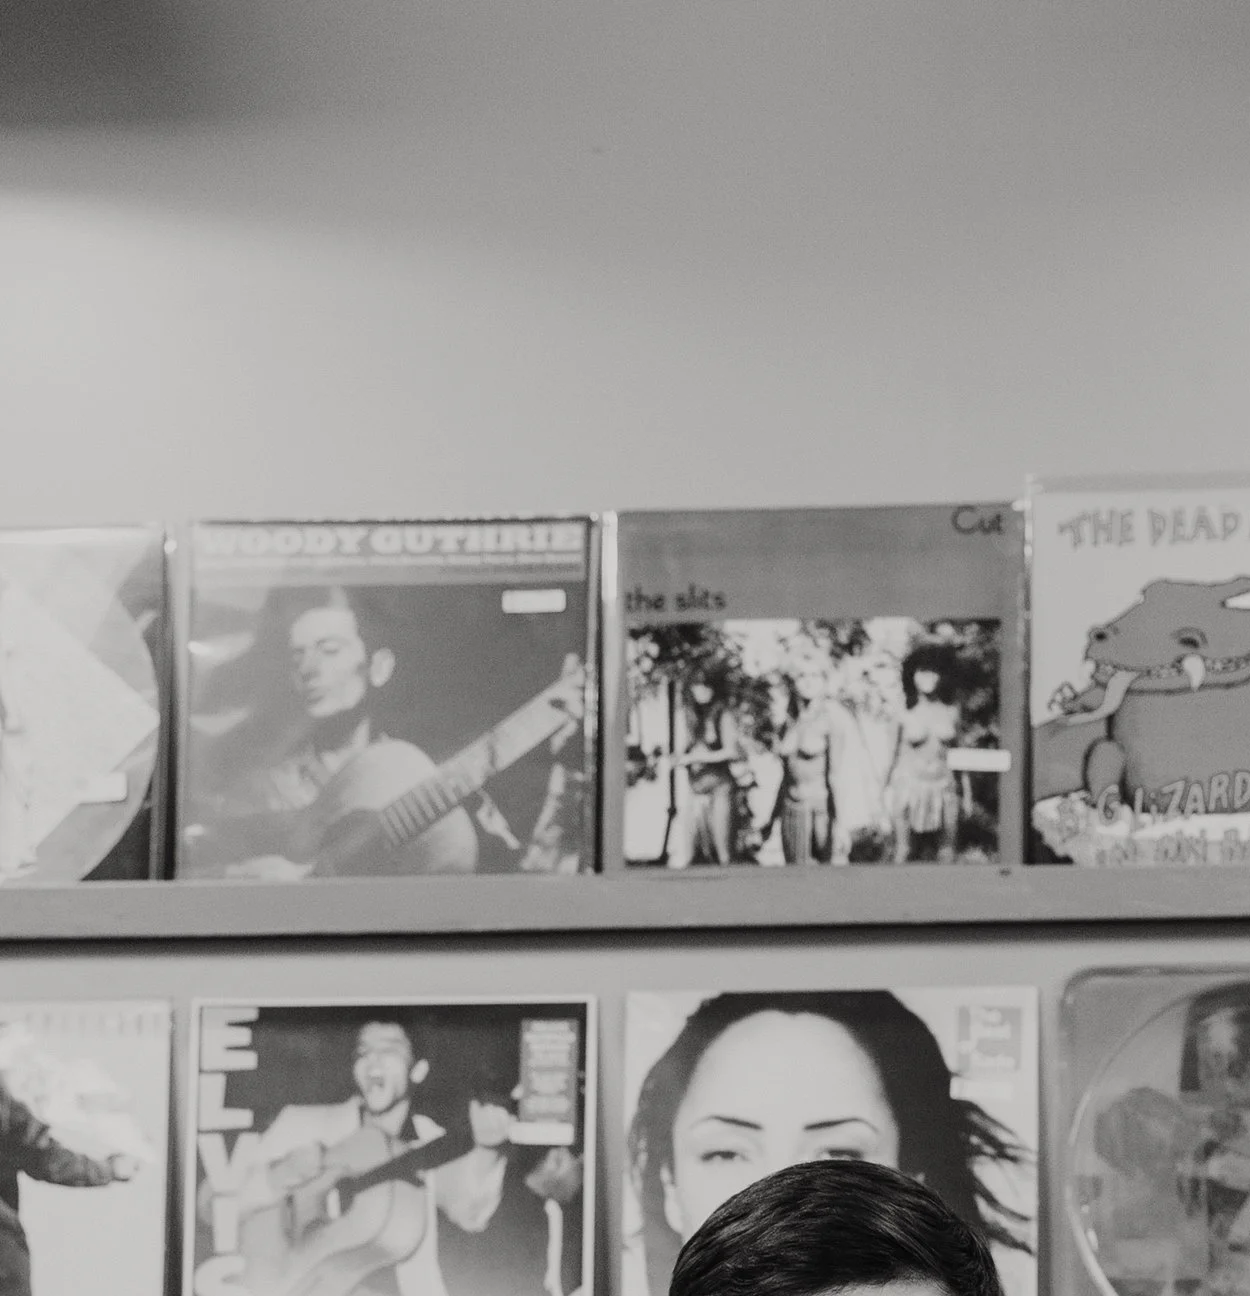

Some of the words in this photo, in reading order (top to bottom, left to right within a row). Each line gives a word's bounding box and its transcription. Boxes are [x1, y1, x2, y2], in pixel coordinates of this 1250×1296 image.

[951, 505, 1002, 535] Cut
[1058, 510, 1135, 551] THE
[1147, 506, 1241, 546] DEAD
[198, 528, 361, 555] WOODY
[370, 524, 582, 552] GUTHRIE
[625, 582, 665, 612] the
[676, 580, 726, 612] slits
